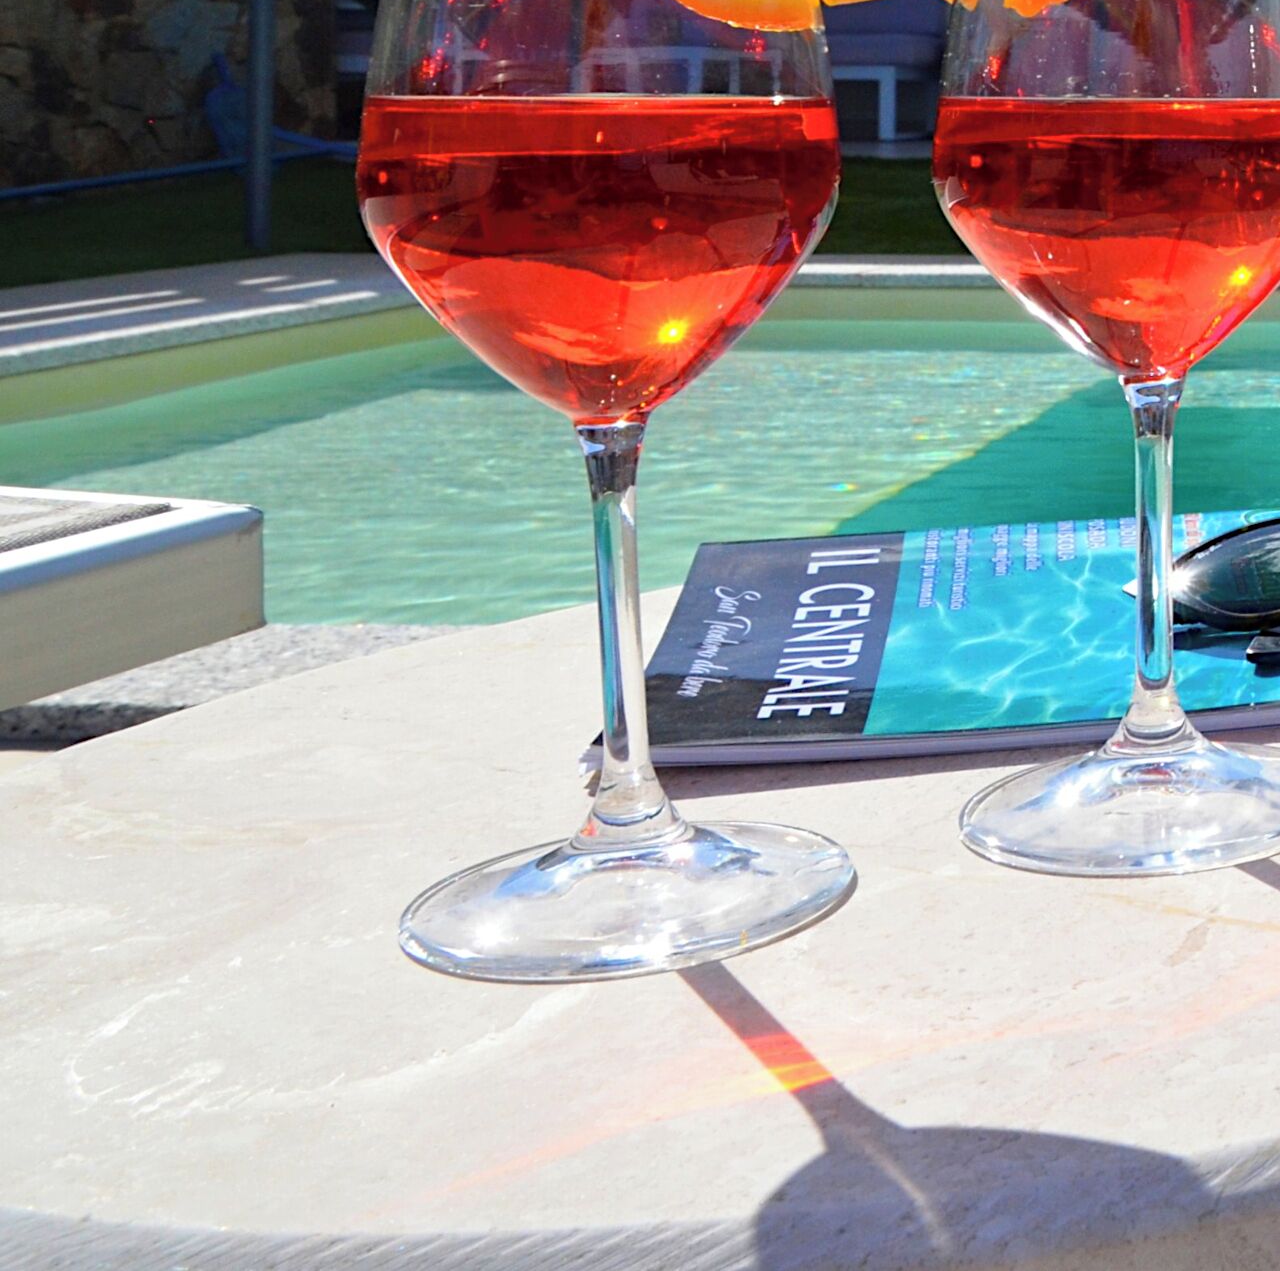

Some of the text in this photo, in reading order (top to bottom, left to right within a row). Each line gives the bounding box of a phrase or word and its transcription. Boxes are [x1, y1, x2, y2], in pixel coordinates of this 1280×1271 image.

[676, 585, 762, 698] San Teodoro da bere
[756, 548, 881, 719] IL CENTRALE
